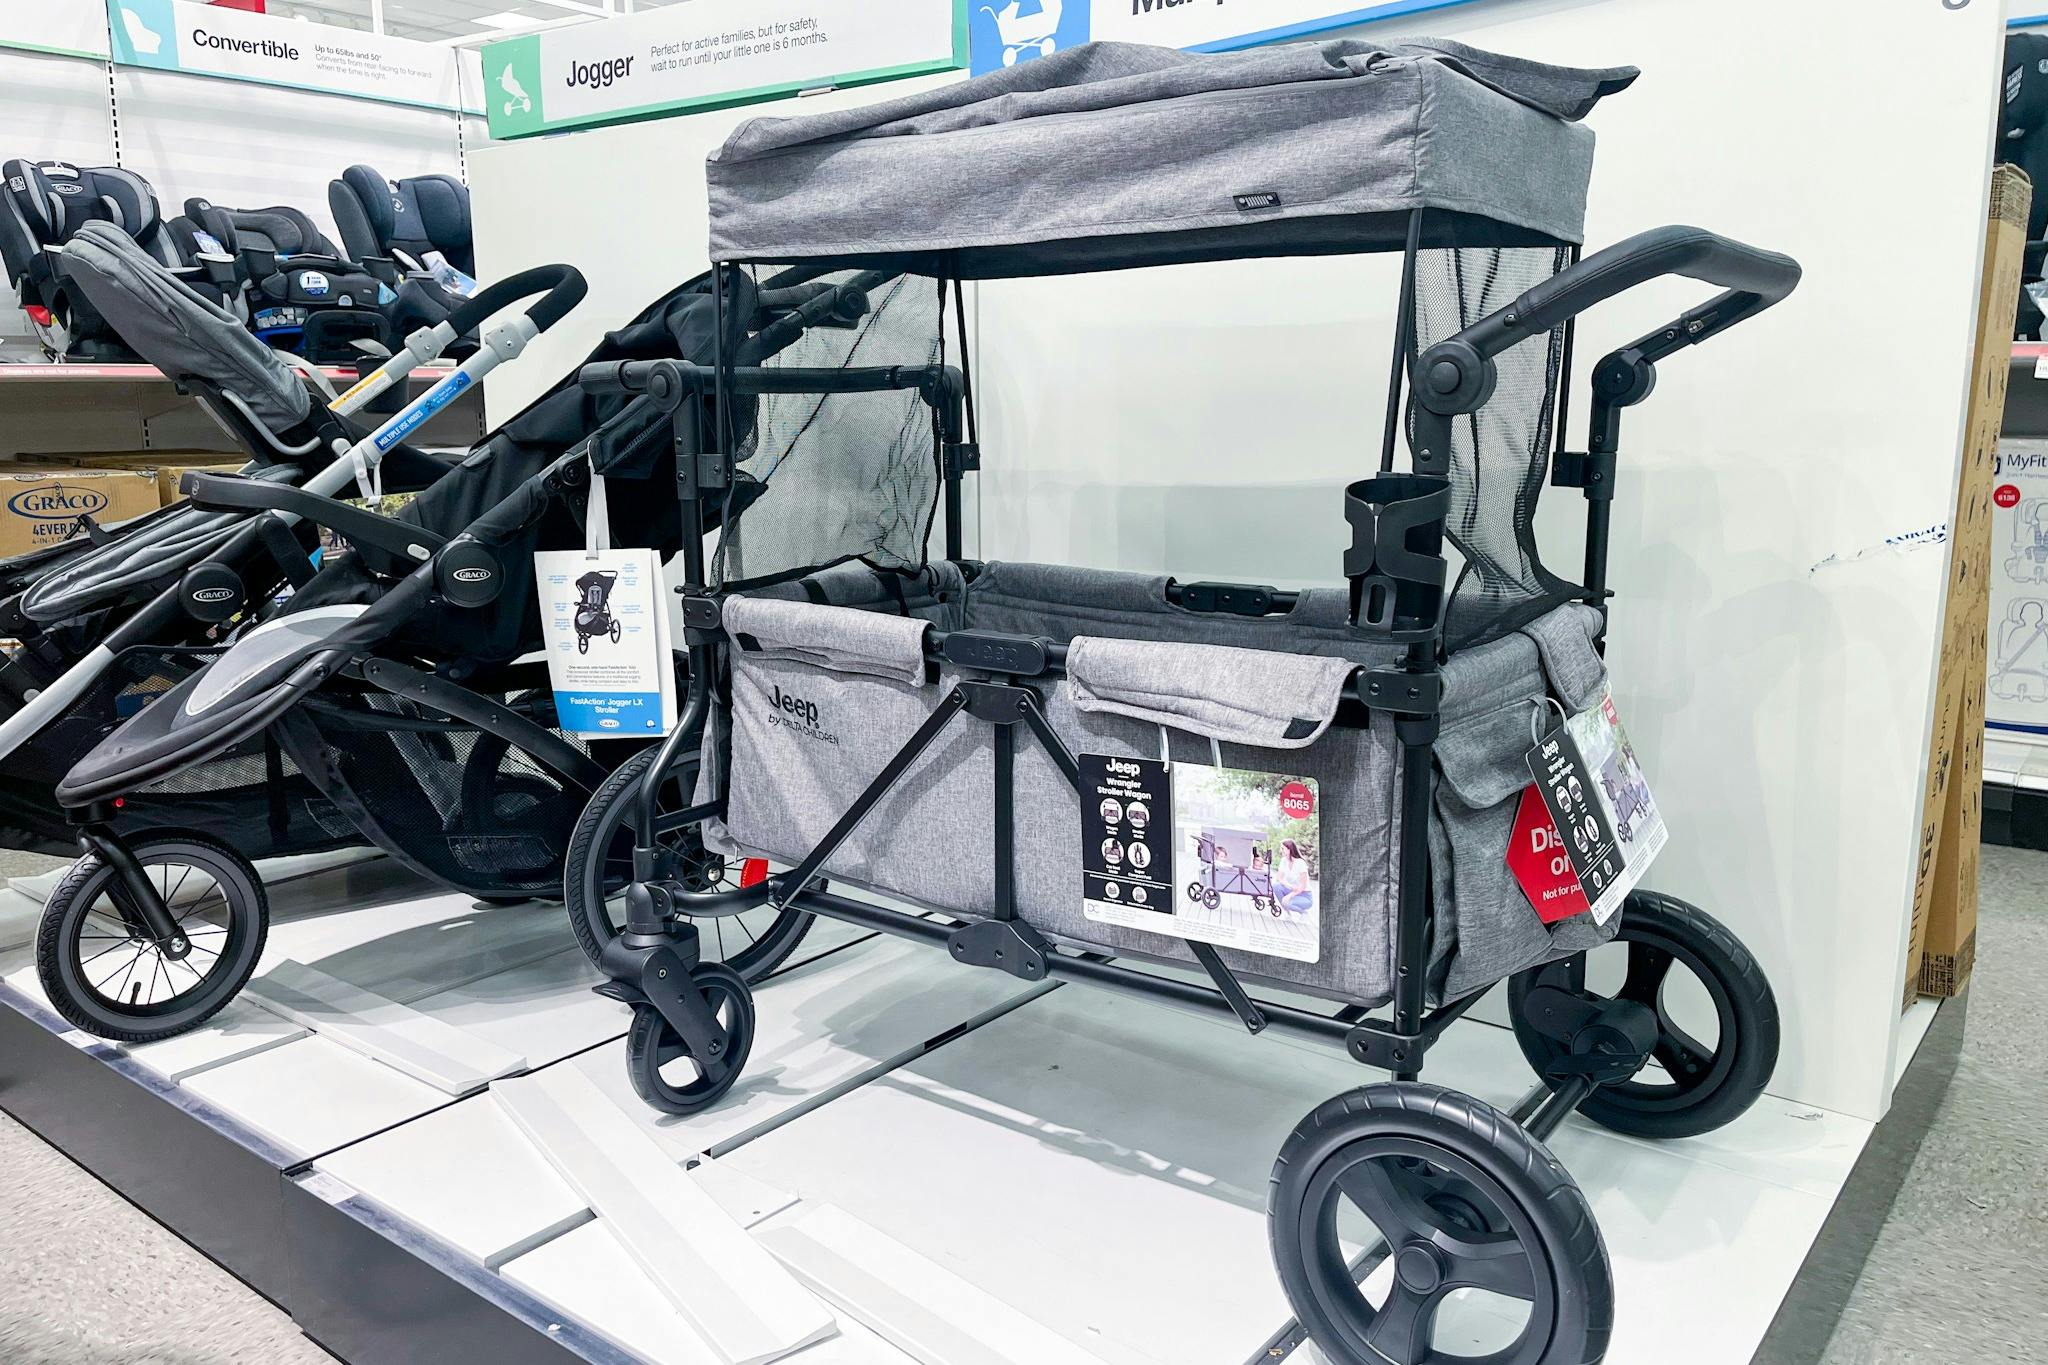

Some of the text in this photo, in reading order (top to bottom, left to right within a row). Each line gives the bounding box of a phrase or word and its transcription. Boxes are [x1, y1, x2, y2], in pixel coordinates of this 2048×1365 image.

[192, 28, 300, 61] Convertible
[651, 17, 818, 58] Perfect for active families, but for safety,
[650, 31, 829, 73] wait to run until your little one is 6 months.
[566, 55, 634, 89] Jogger
[378, 427, 401, 447] MULTIPLE
[399, 420, 409, 432] USE
[23, 494, 98, 512] GRACO
[32, 523, 67, 536] 4EVER
[459, 570, 488, 580] GRACO
[198, 589, 230, 600] GRACO
[570, 697, 644, 708] FastAction Jogger LX
[594, 706, 619, 714] Stroller
[767, 685, 819, 727] Jeep
[768, 714, 839, 745] by DELTA CHILDREN
[1106, 758, 1141, 777] Jeep
[1106, 777, 1142, 790] Wrangler
[1097, 785, 1152, 801] Stroller Wagon
[1283, 798, 1310, 811] 8065
[1542, 889, 1558, 901] Not
[1558, 885, 1570, 896] for
